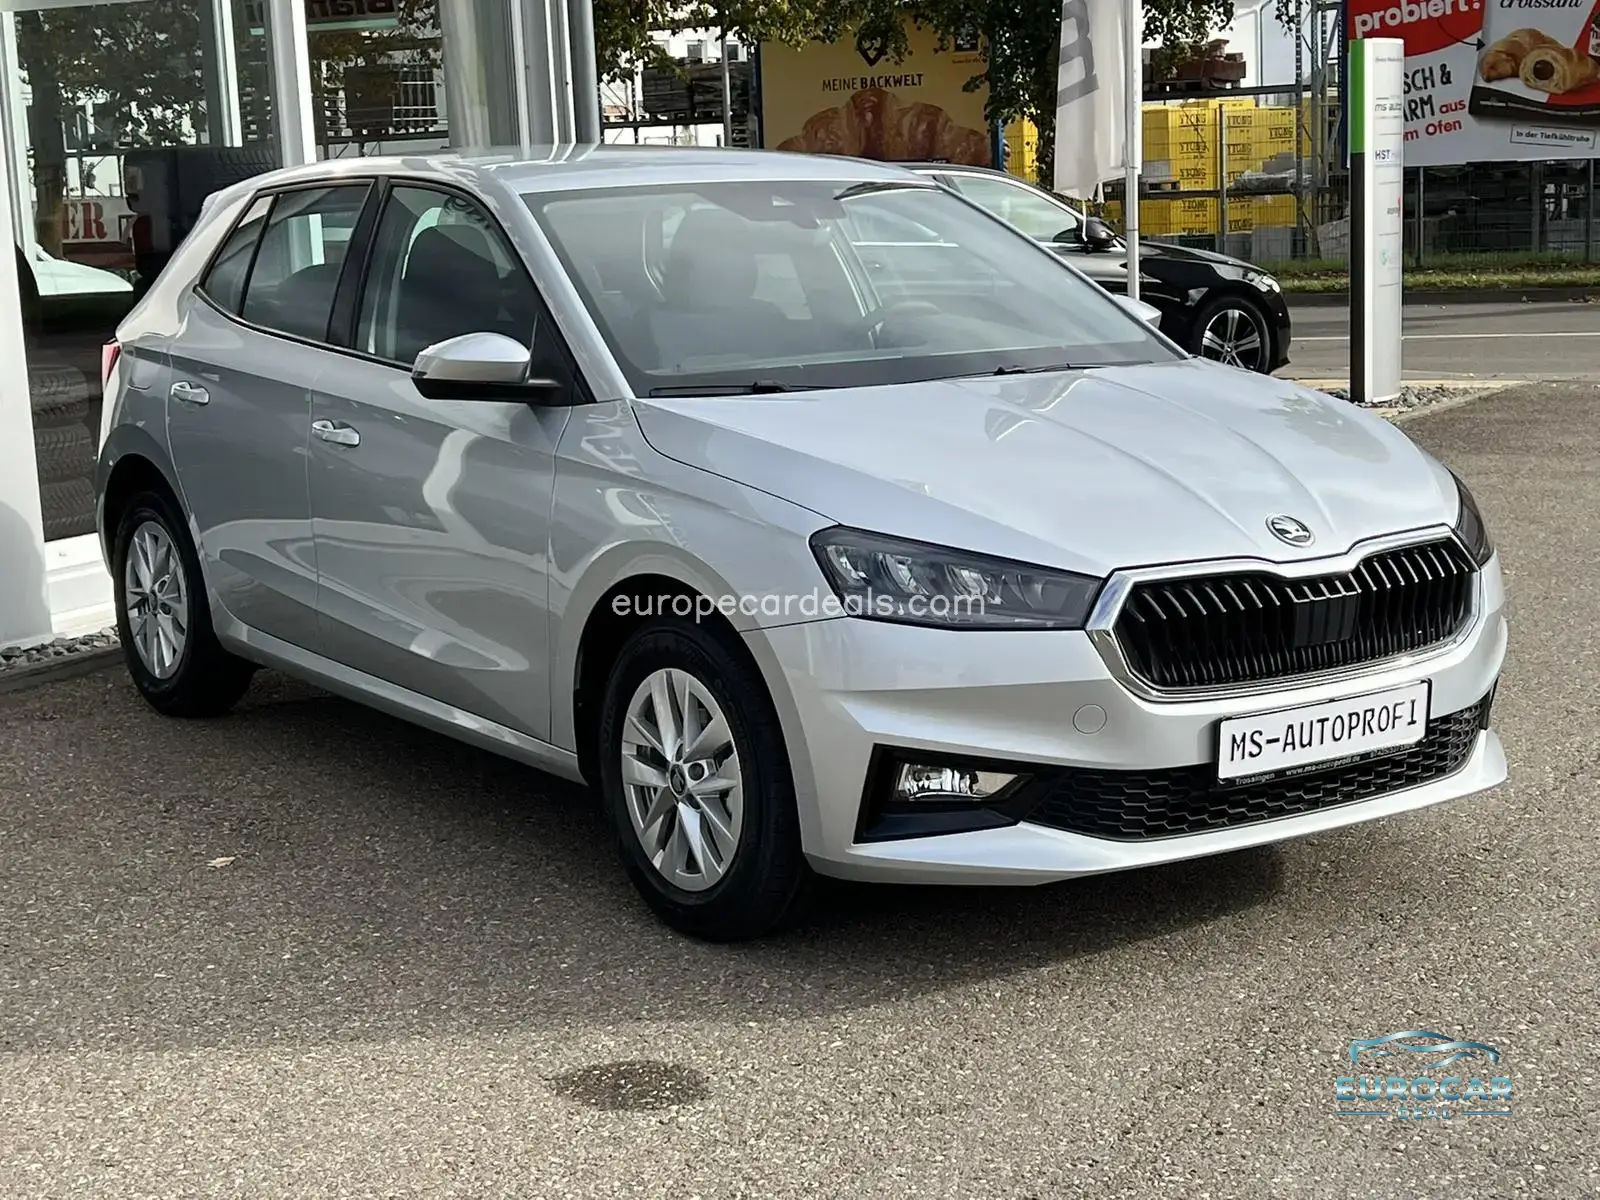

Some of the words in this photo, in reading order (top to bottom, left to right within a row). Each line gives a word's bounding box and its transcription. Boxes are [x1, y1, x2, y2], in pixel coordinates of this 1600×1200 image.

[822, 77, 858, 92] MEINE
[860, 73, 924, 89] BACKWELT
[1440, 63, 1452, 86] &
[1439, 99, 1466, 114] aus
[1425, 119, 1462, 136] Ofen
[1375, 149, 1390, 160] HST
[1230, 699, 1417, 762] MS-AUTOPROFI
[1235, 772, 1276, 786] Trossingen
[1286, 755, 1361, 776] www.ms-autoprofi.de
